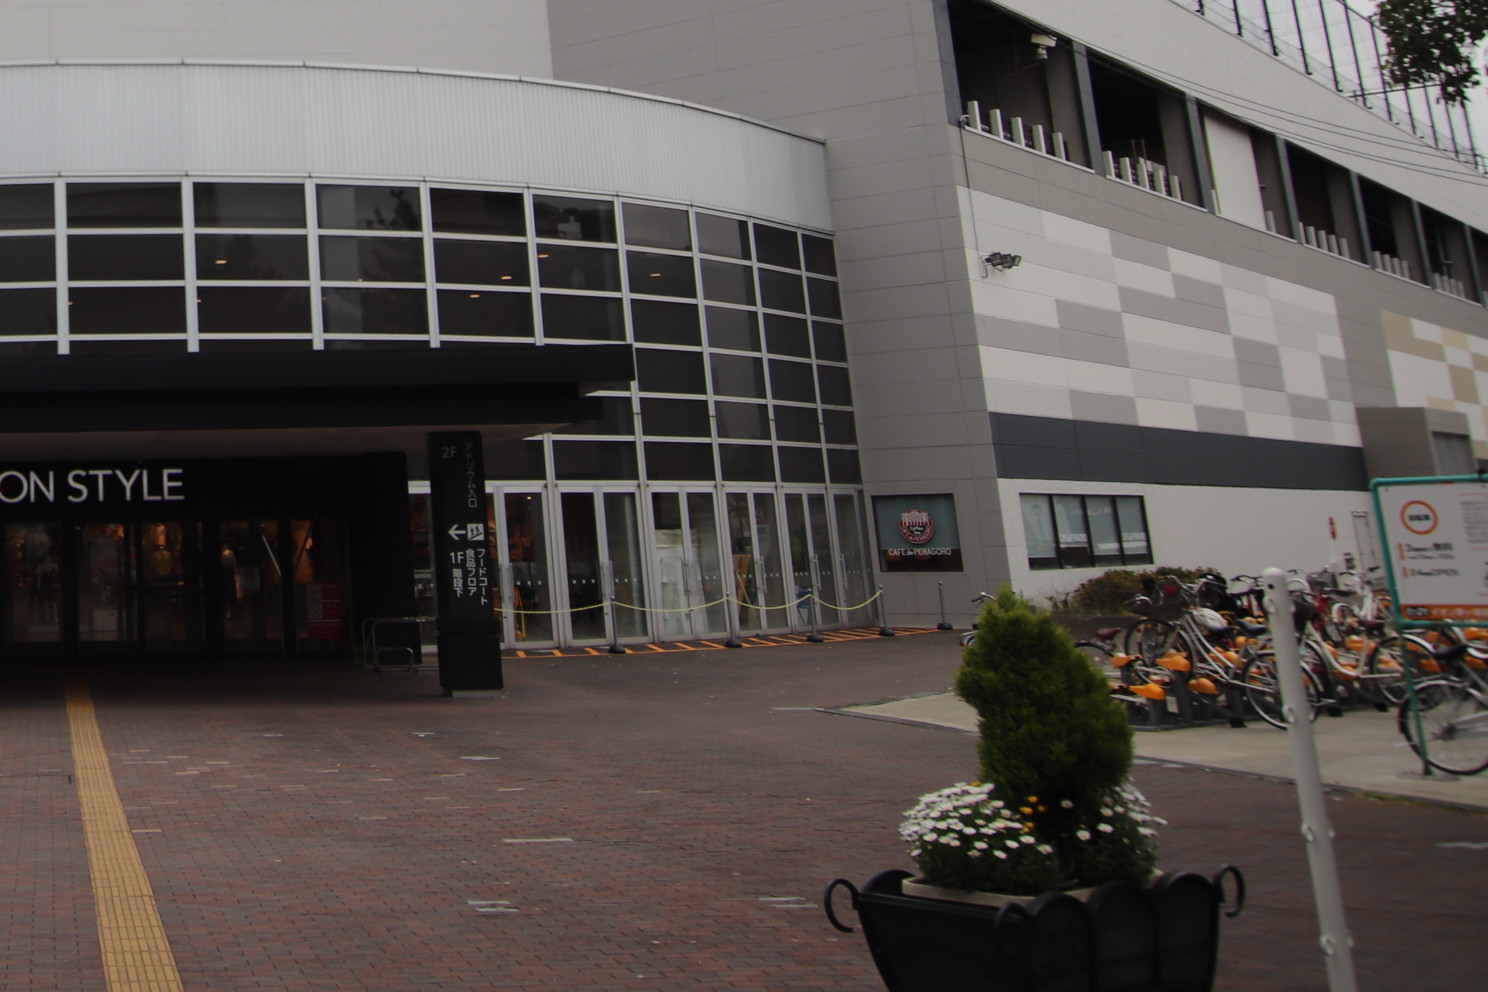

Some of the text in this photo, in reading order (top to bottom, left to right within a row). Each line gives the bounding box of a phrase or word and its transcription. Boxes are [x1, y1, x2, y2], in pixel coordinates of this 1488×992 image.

[442, 446, 457, 459] 2F
[67, 468, 185, 503] STYLE
[464, 442, 478, 508] アトリウム入口
[449, 551, 464, 564] 1F
[888, 548, 906, 556] CAFE
[914, 547, 952, 556] PERAGORO
[465, 548, 477, 597] 食品フロア
[477, 548, 488, 606] フードコート
